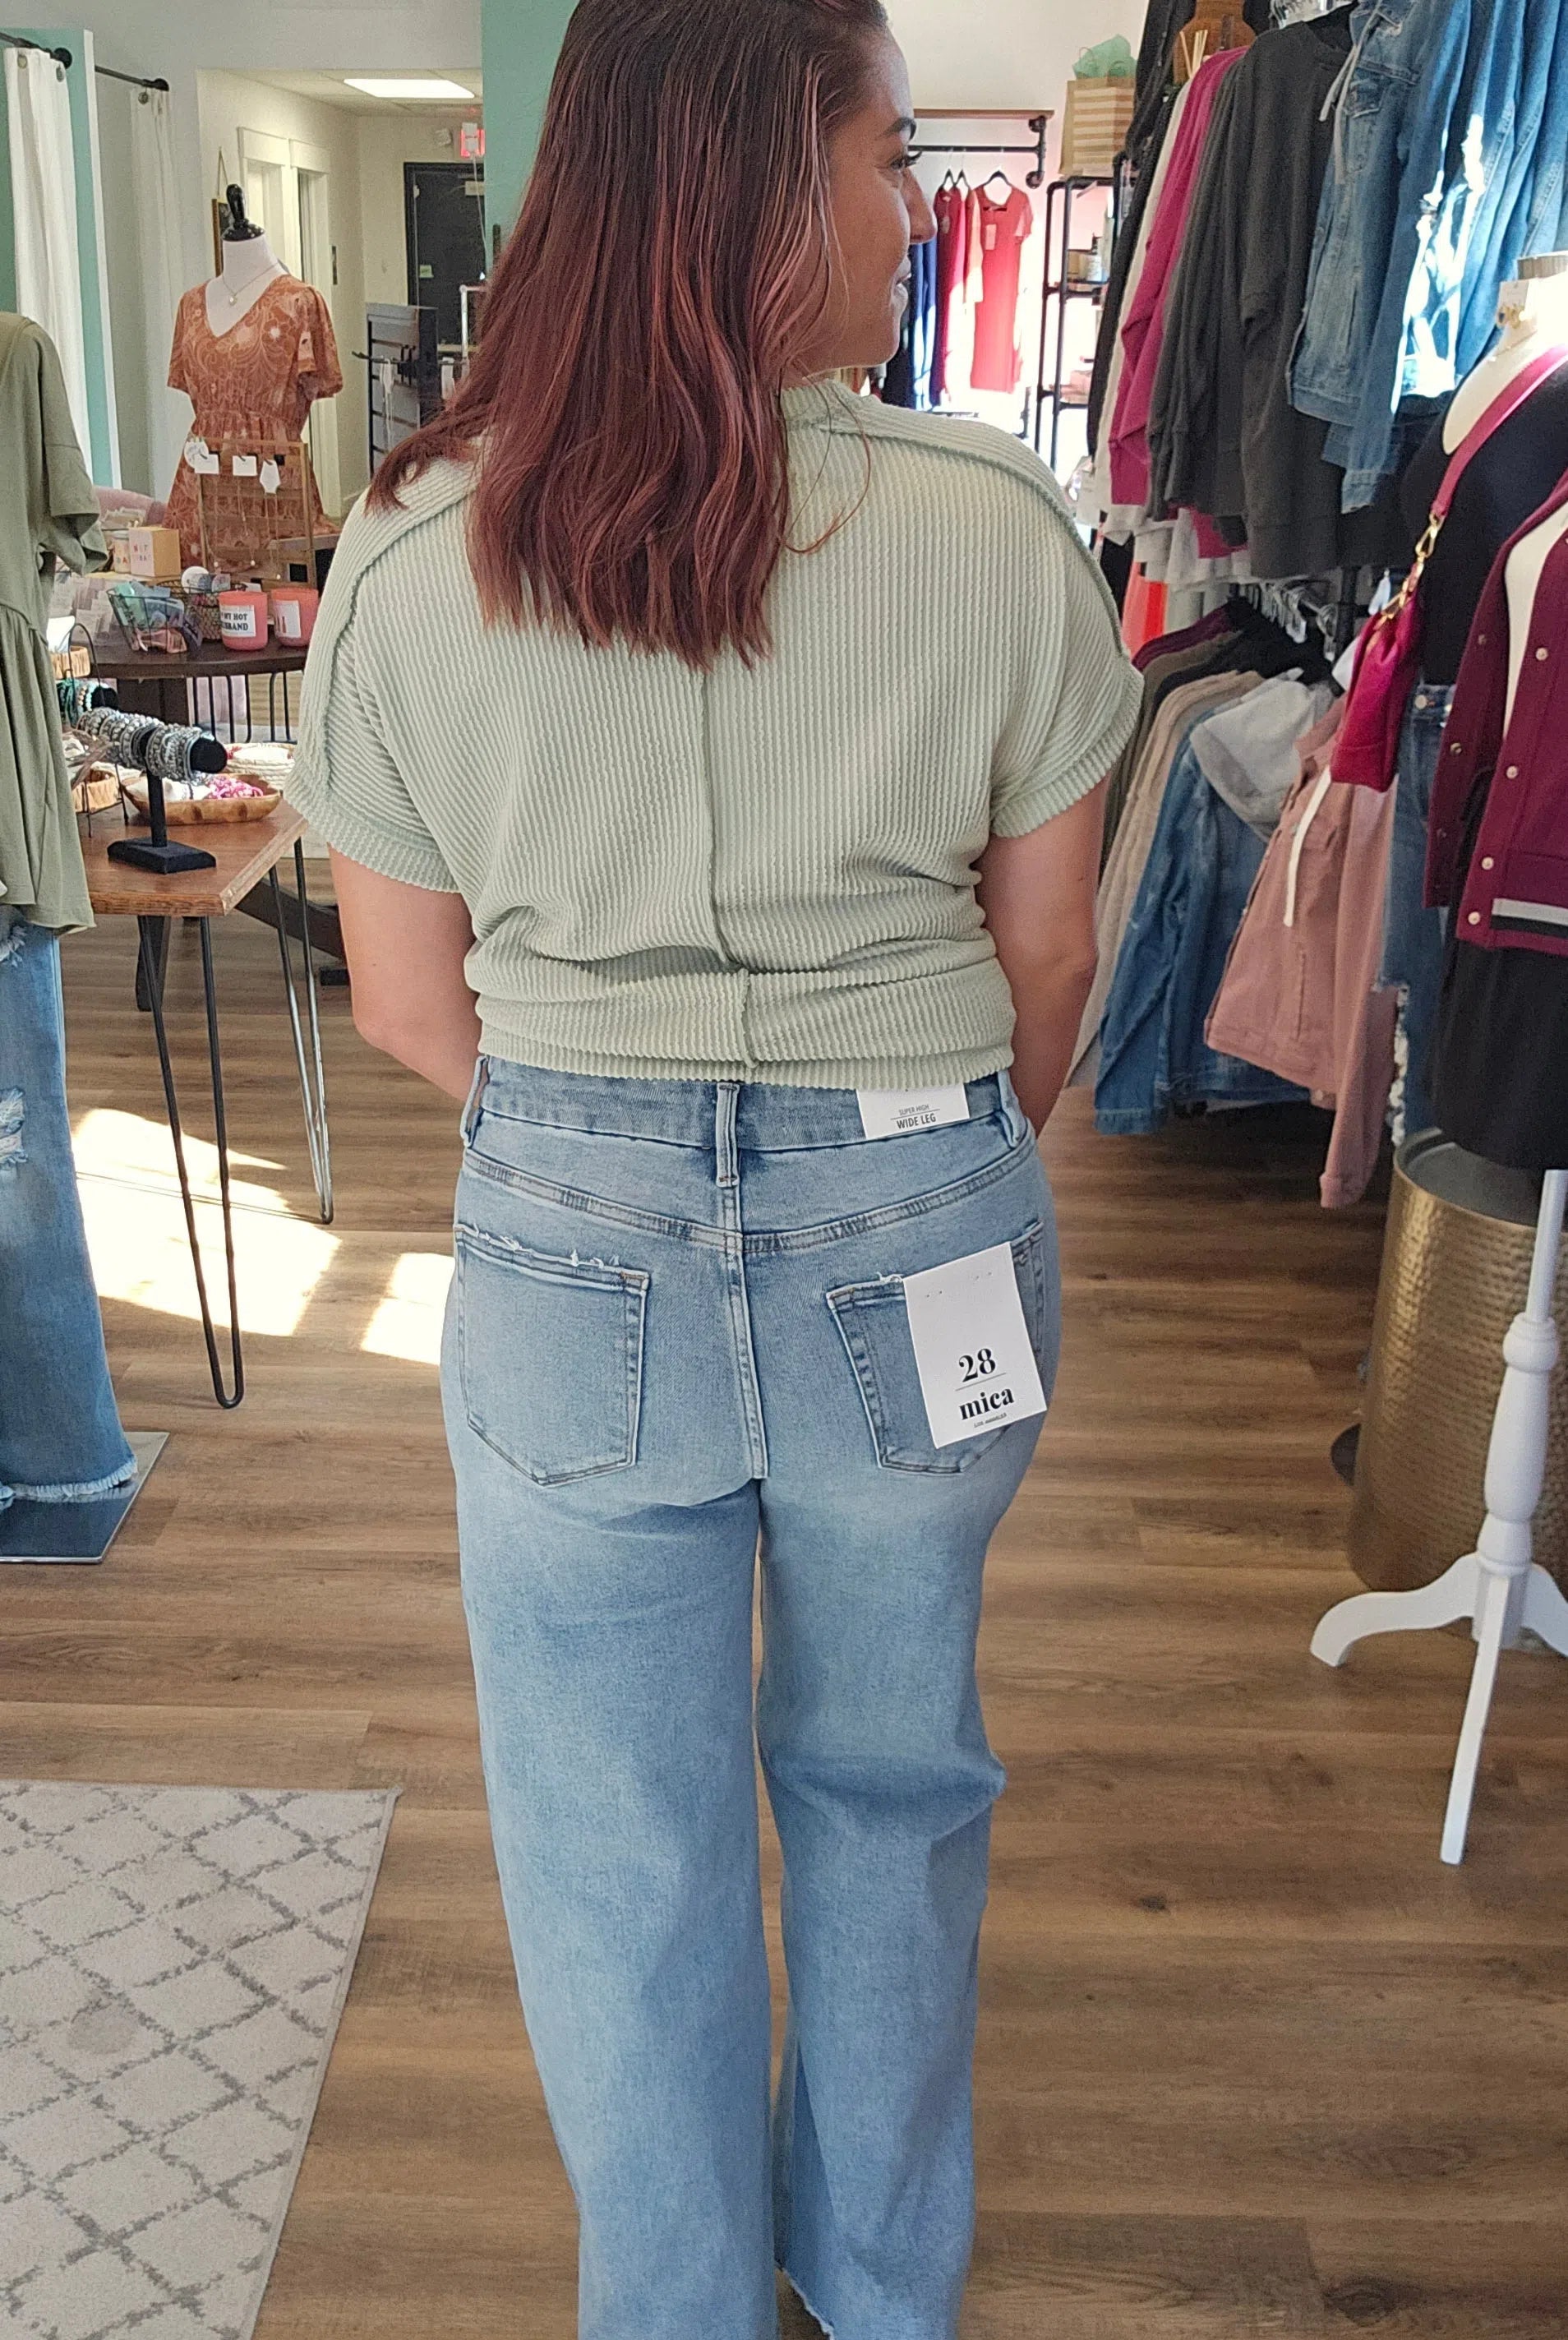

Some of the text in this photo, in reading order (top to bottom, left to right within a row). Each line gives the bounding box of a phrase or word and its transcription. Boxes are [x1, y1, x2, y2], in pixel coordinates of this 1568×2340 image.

[233, 612, 248, 621] HOT
[222, 622, 249, 631] BAND
[896, 1113, 936, 1129] WIDE LEG
[958, 1348, 996, 1382] 28
[958, 1388, 1015, 1420] mica
